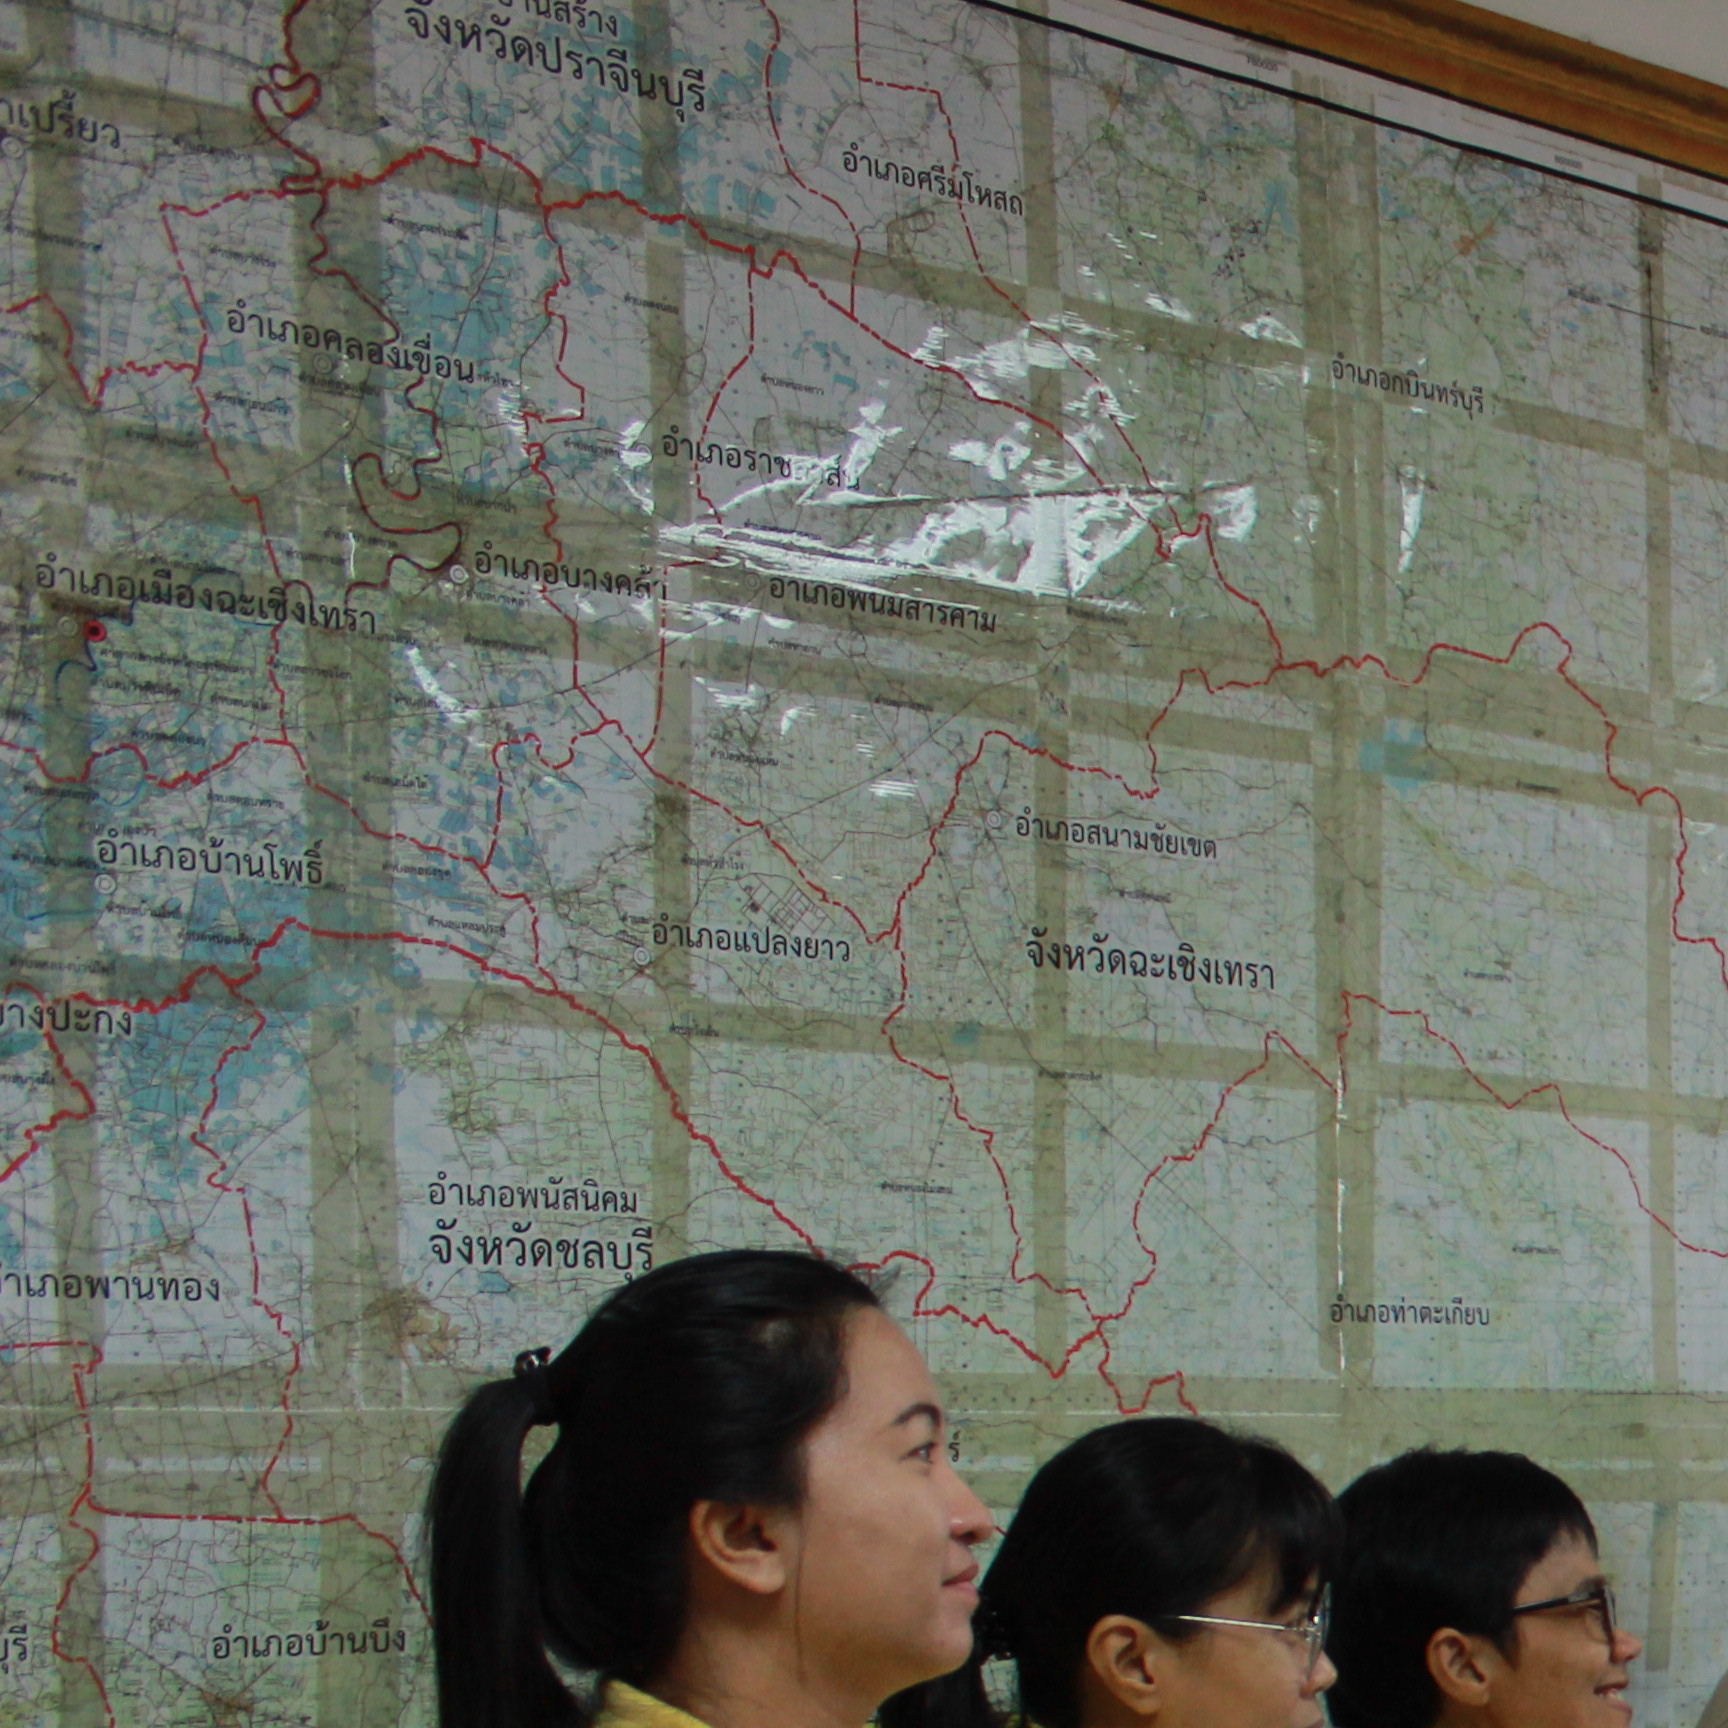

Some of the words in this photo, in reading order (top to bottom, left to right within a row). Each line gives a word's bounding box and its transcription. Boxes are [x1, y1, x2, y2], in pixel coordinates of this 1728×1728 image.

[404, 7, 706, 123] จังหวัดปราจีนบุรี
[842, 142, 1023, 216] อำเภอศรีมโหสถ
[226, 299, 474, 384] อำเภอคลองเขื่อน
[1332, 352, 1483, 421] อำเภอกบินทร์บุรี
[662, 425, 860, 491] อำเภอราชส์น
[36, 552, 376, 634] อำเภอเมืองฉะเชิงเทรา
[475, 541, 667, 600] อำเภอบางคล้า
[97, 828, 324, 885] อำเภอบ้านโพธิ์
[1016, 806, 1217, 859] อำเภอสนามชัยเขต
[652, 913, 850, 962] อำเภอแปลงยาว
[1025, 926, 1274, 990] จังหวัดฉะเชิงเทรา
[427, 1172, 638, 1214] อำเภอพนัสนิคม
[428, 1220, 654, 1283] จังหวัดชลบุรี
[1330, 1293, 1490, 1327] อำเภอท่าตะเกียบ
[212, 1617, 407, 1661] อำเภอบ้านบึง
